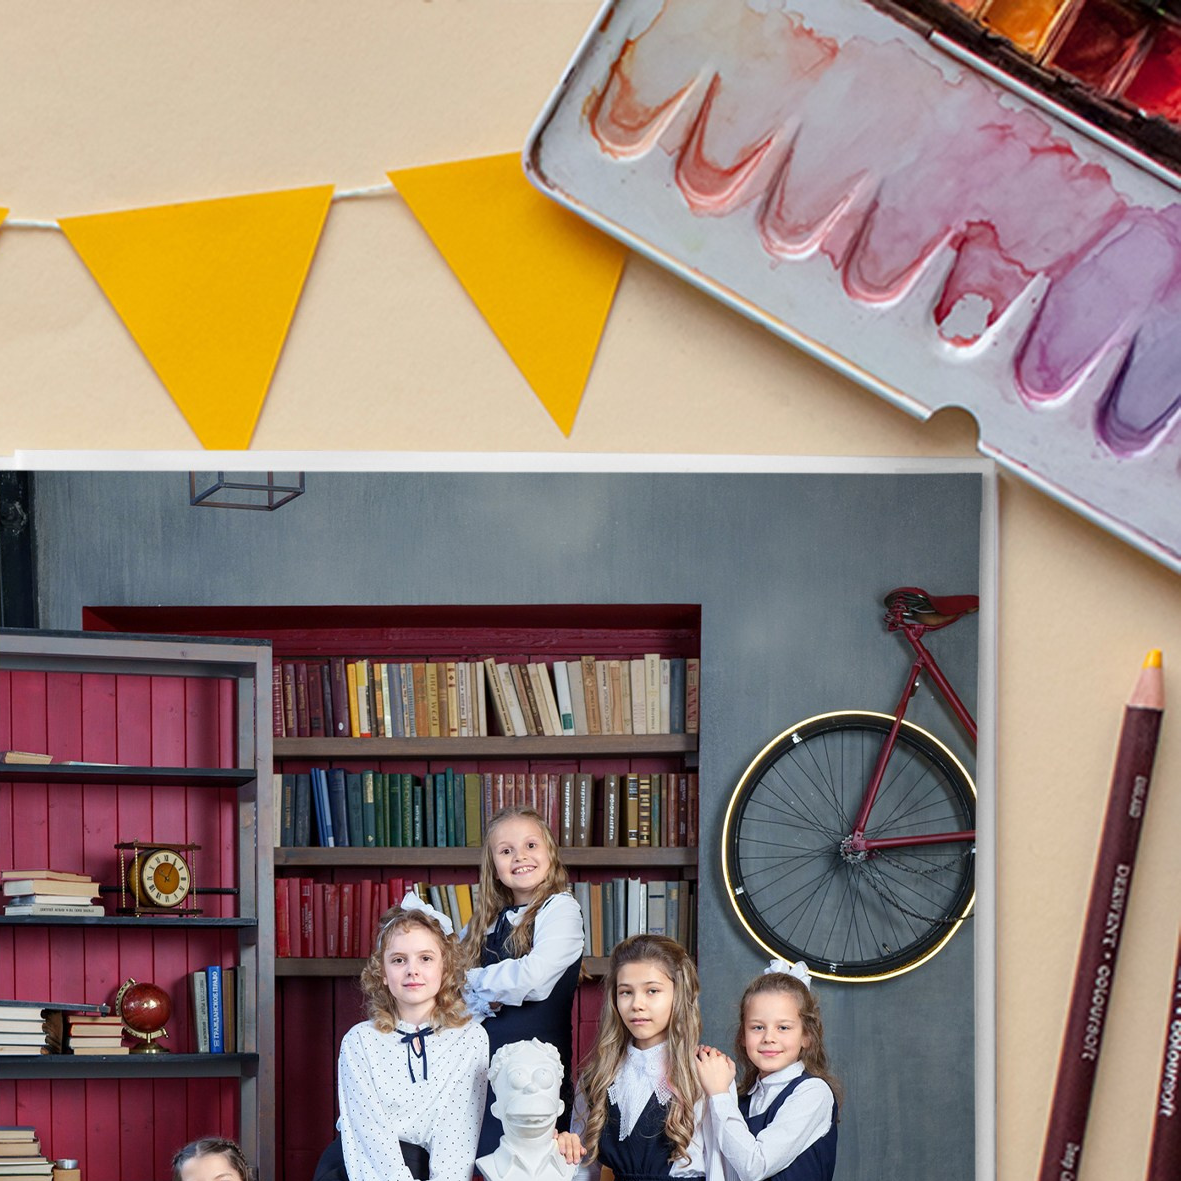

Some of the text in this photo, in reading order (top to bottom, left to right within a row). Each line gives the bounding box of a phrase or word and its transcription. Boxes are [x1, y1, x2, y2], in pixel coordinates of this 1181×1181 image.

[212, 992, 220, 1039] ГРАЖДАНСКОЕ
[1080, 863, 1131, 1062] DERWENT coloursoft
